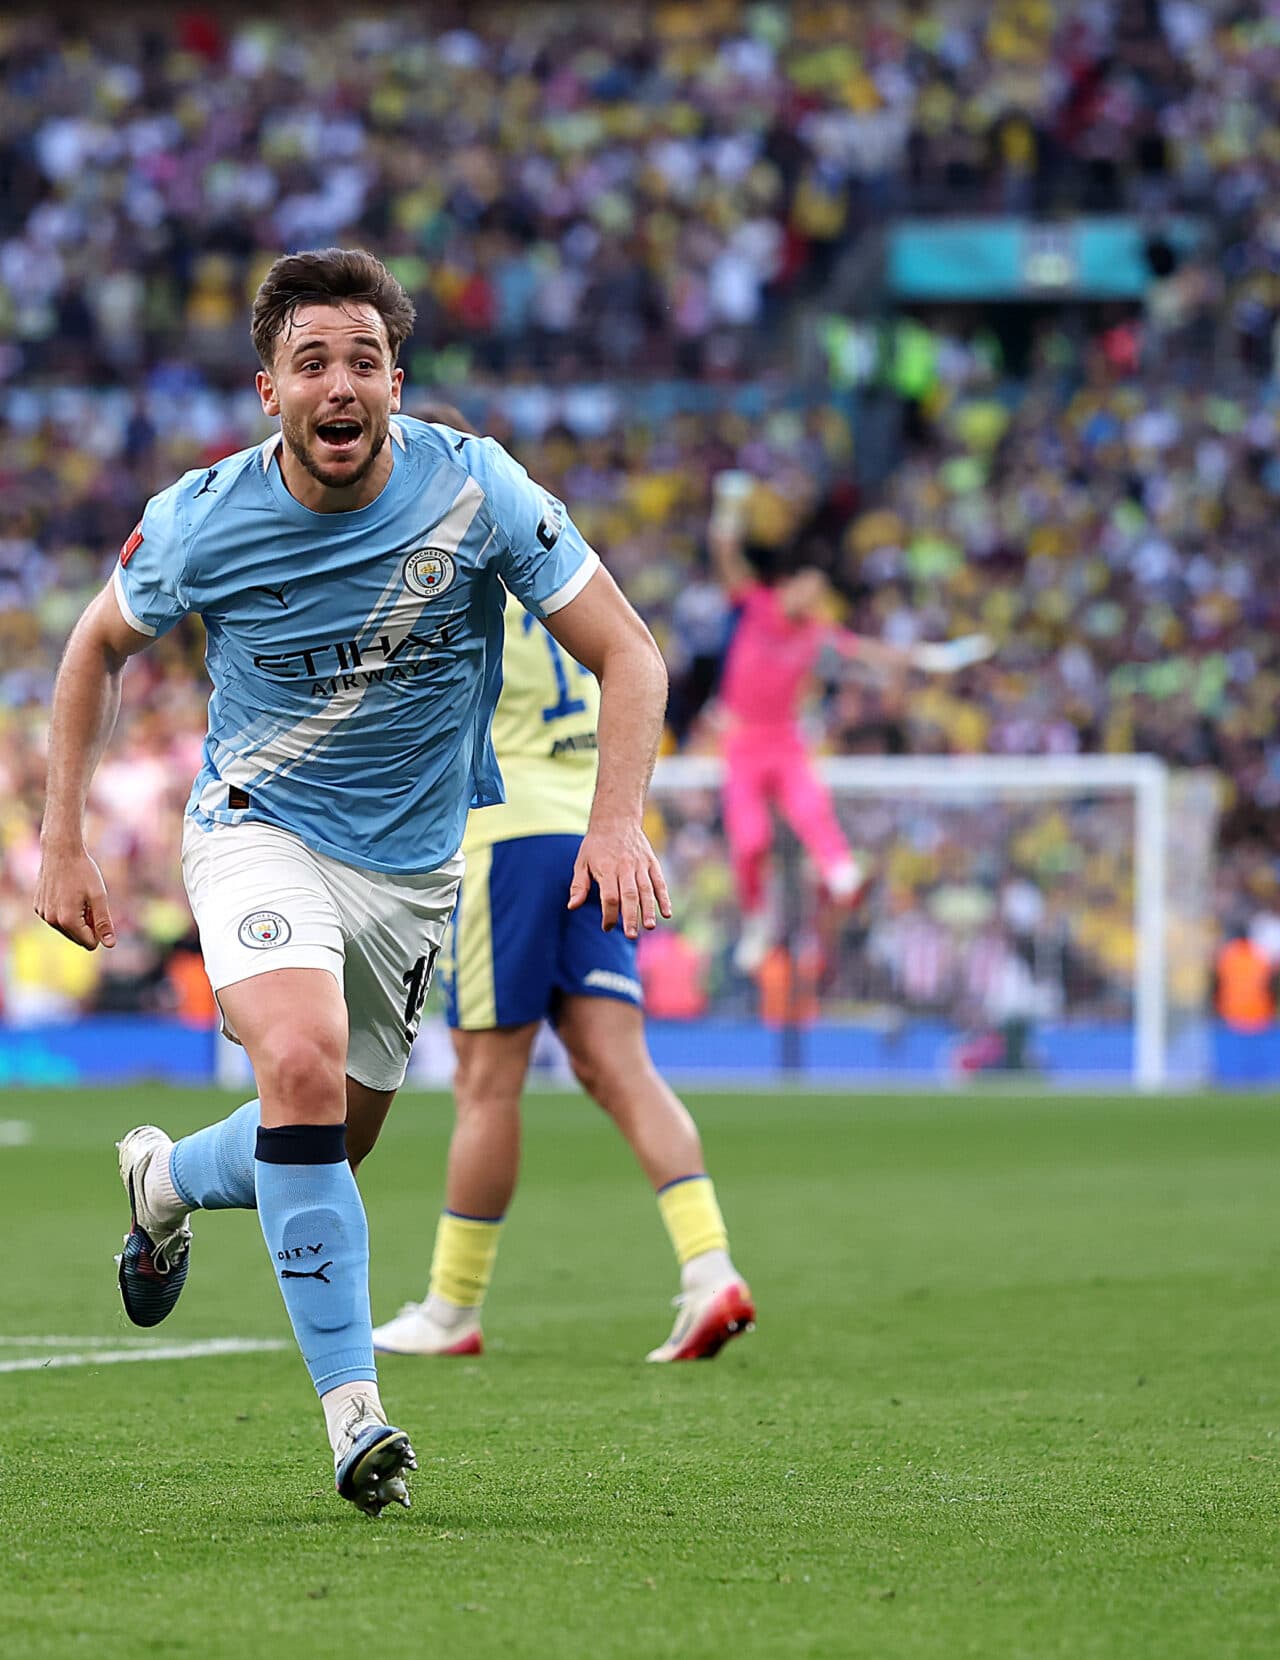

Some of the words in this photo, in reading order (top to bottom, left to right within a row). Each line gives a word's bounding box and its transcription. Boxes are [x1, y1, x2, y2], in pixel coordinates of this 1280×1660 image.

[407, 550, 450, 569] MANCHESTER
[424, 587, 441, 595] CITY
[277, 1242, 324, 1261] CITY
